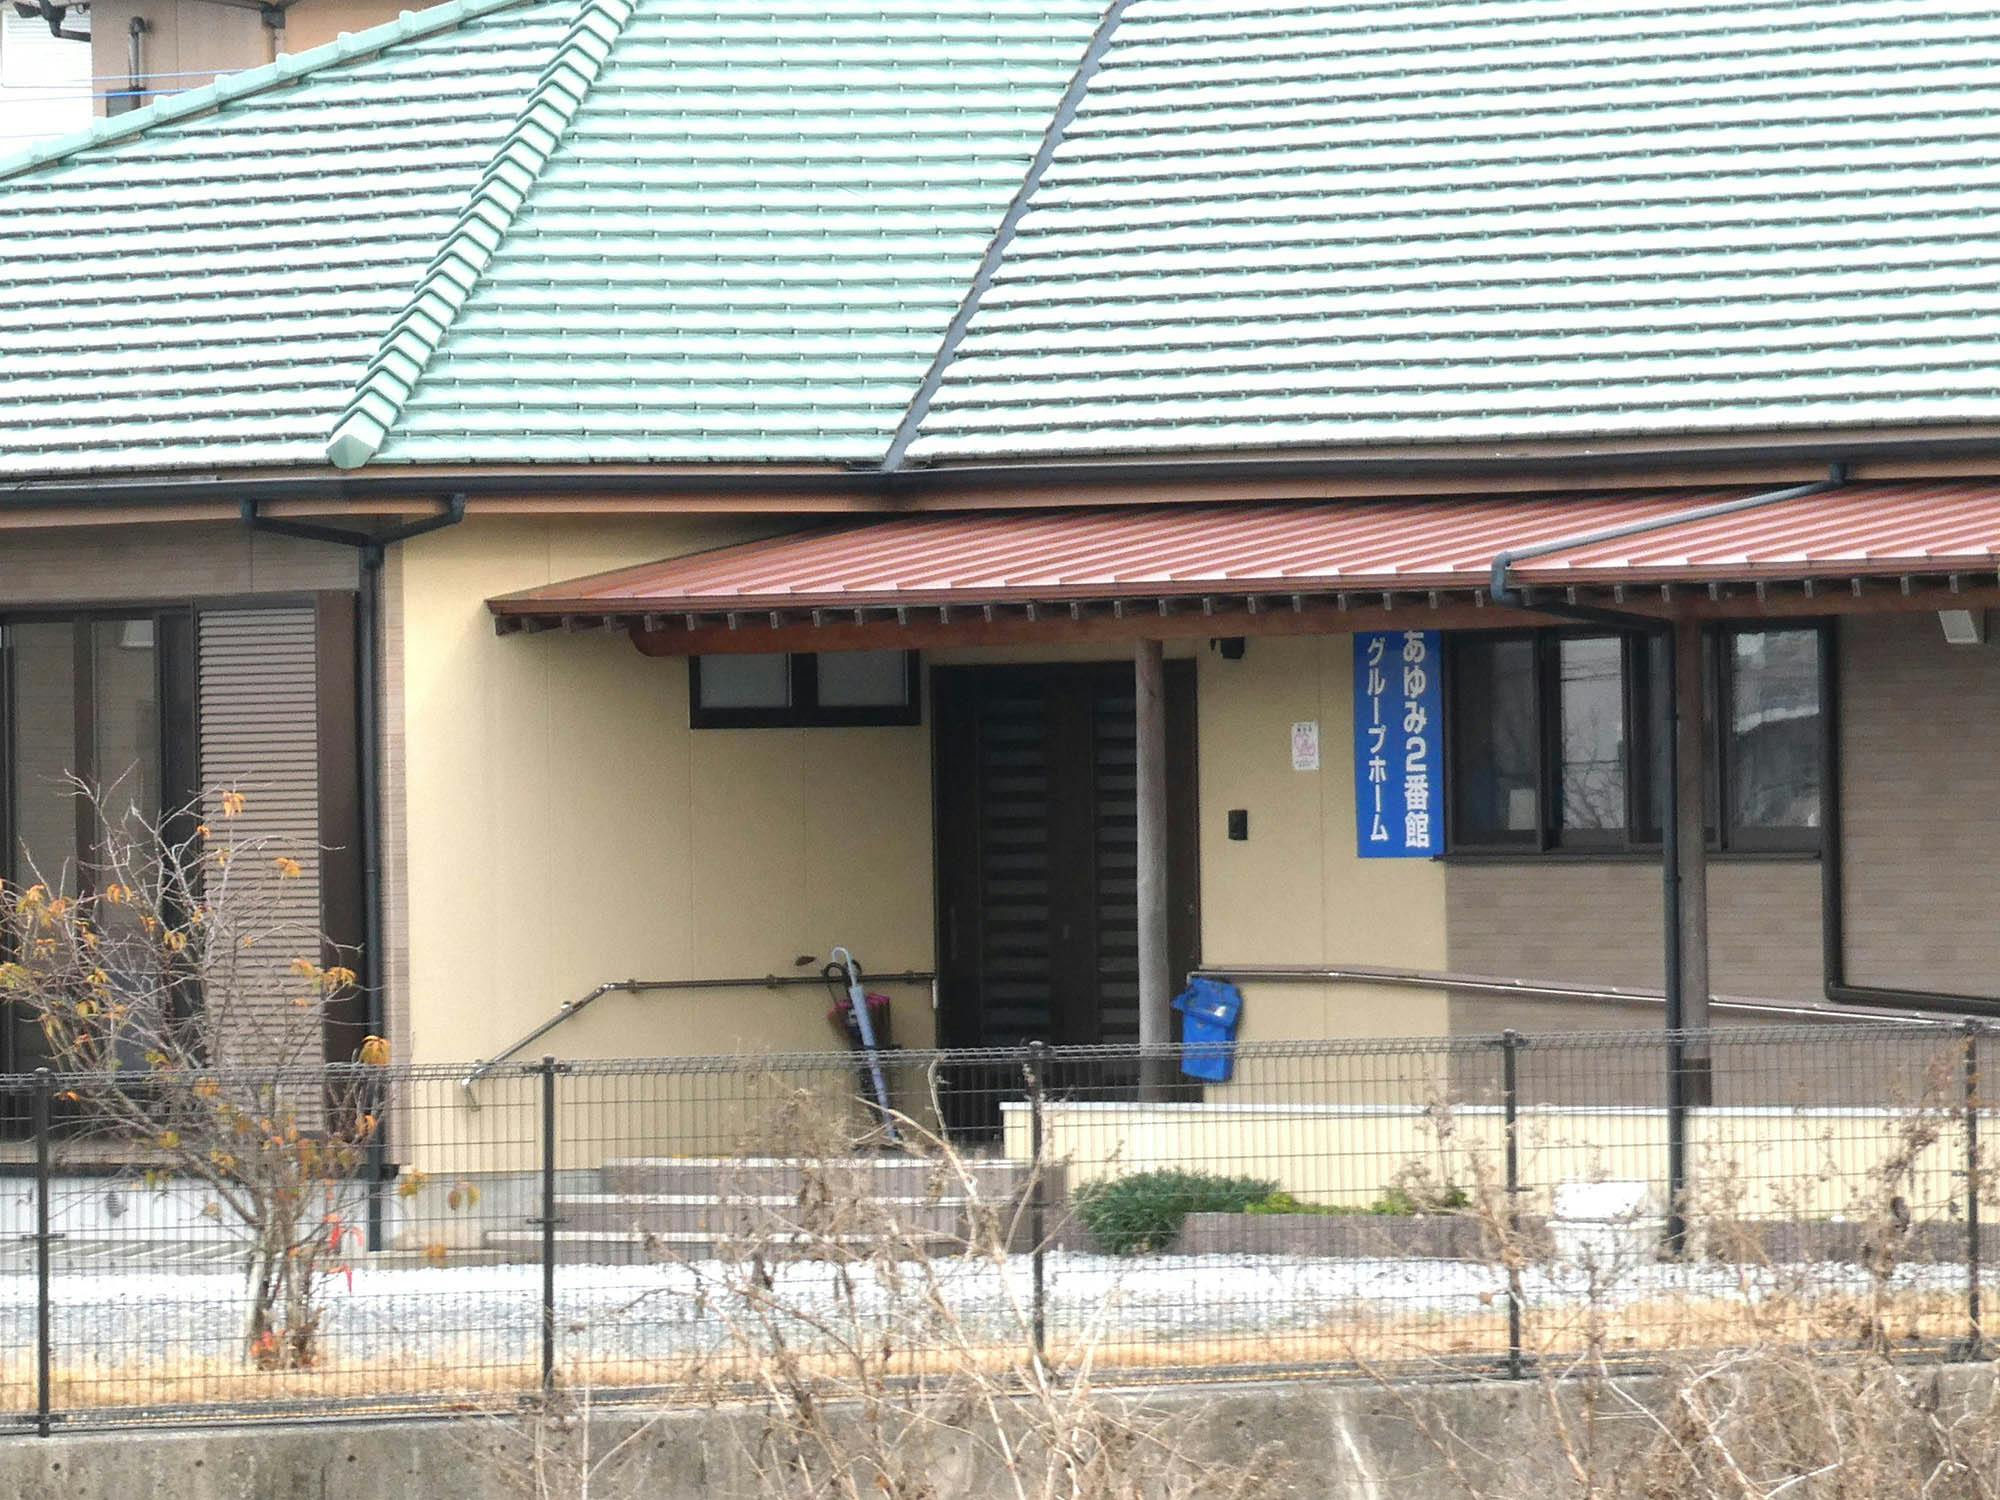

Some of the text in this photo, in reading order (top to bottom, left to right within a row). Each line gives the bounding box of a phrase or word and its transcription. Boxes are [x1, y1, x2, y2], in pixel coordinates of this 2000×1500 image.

[1367, 636, 1389, 841] グループホーム
[1403, 630, 1430, 848] あゆみ2番館
